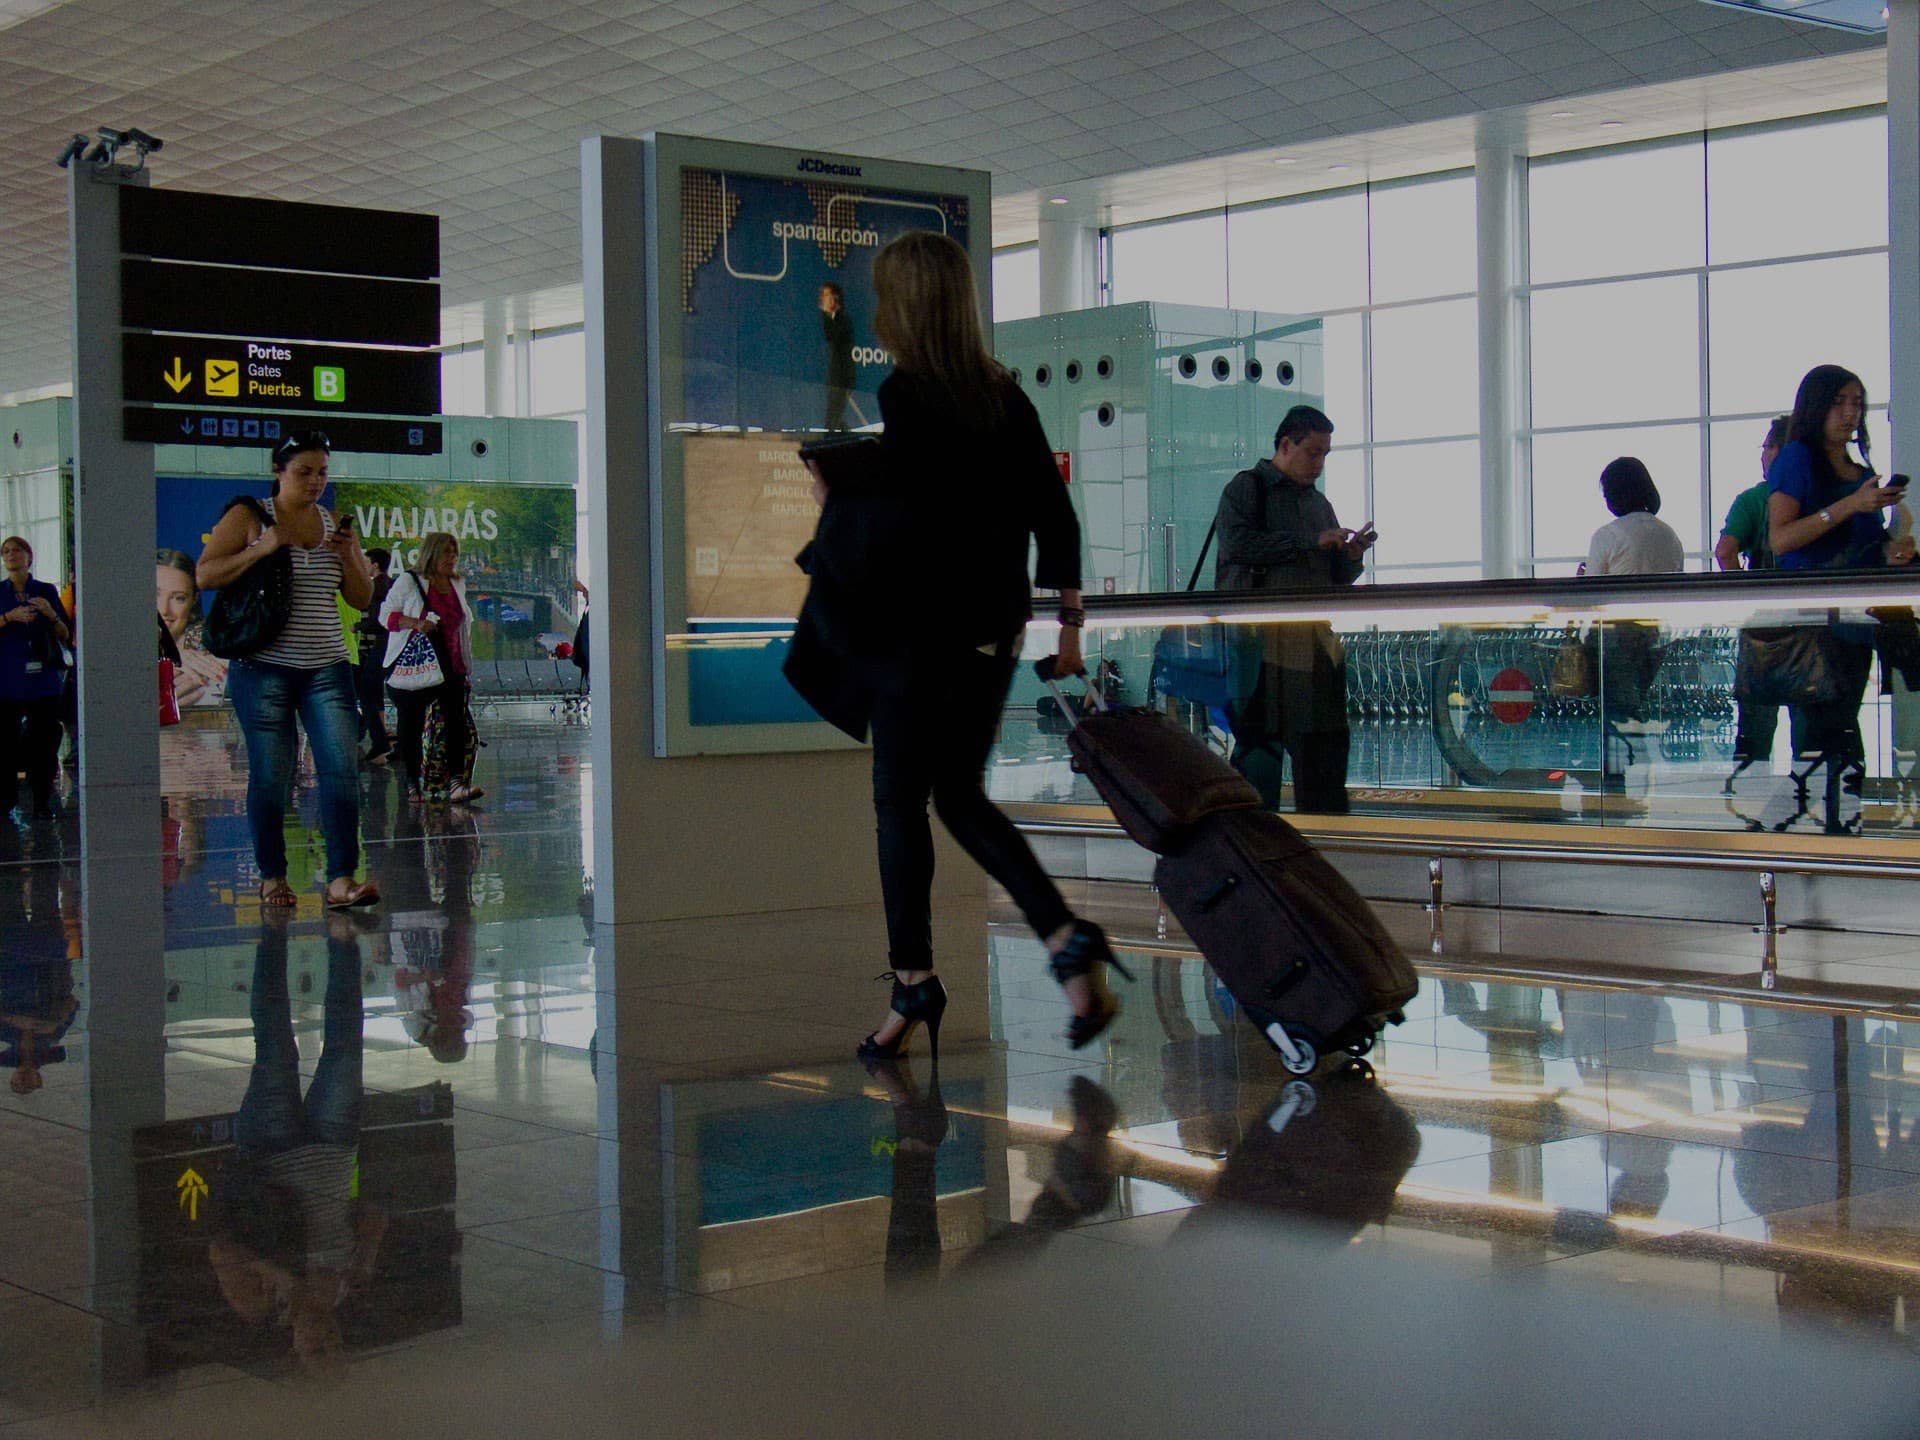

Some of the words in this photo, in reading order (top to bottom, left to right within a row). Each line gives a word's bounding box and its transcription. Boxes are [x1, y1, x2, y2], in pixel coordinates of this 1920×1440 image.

[797, 158, 862, 177] JCDecaux
[772, 221, 879, 247] spanair.com
[247, 343, 293, 361] Portes
[247, 362, 283, 378] Gates
[248, 380, 302, 398] Puertas
[320, 369, 338, 398] B
[355, 501, 498, 540] VIAJARÁS
